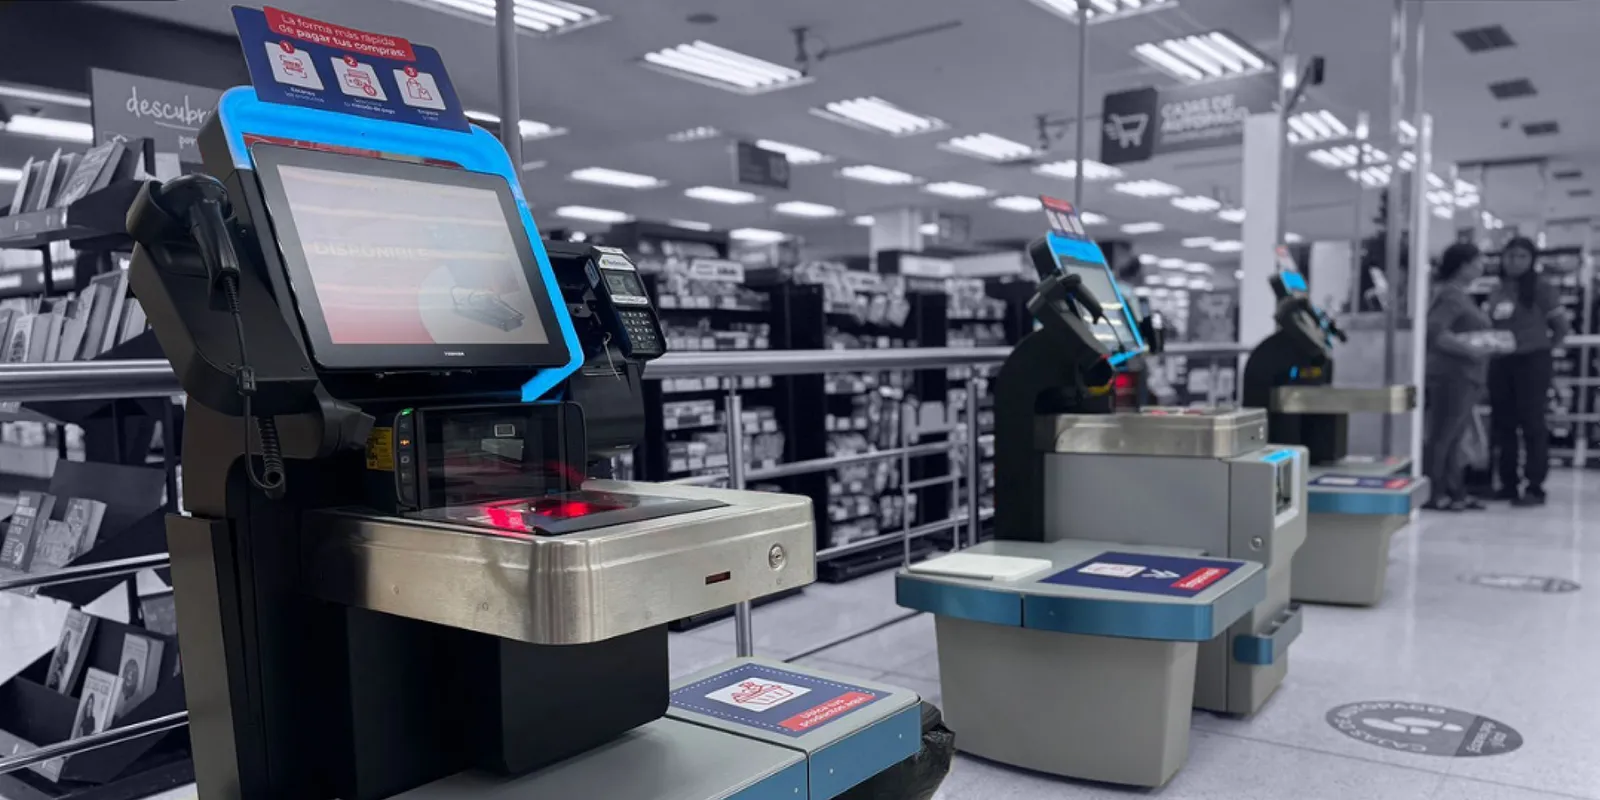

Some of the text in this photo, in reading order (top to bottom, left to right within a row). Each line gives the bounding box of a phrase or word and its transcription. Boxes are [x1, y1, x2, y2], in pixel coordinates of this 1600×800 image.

[278, 24, 294, 35] de
[296, 28, 331, 43] pagar
[332, 37, 353, 49] tus
[281, 14, 396, 48] La forma más rápida
[126, 86, 212, 125] descubr
[314, 241, 429, 260] DISPONIBLE
